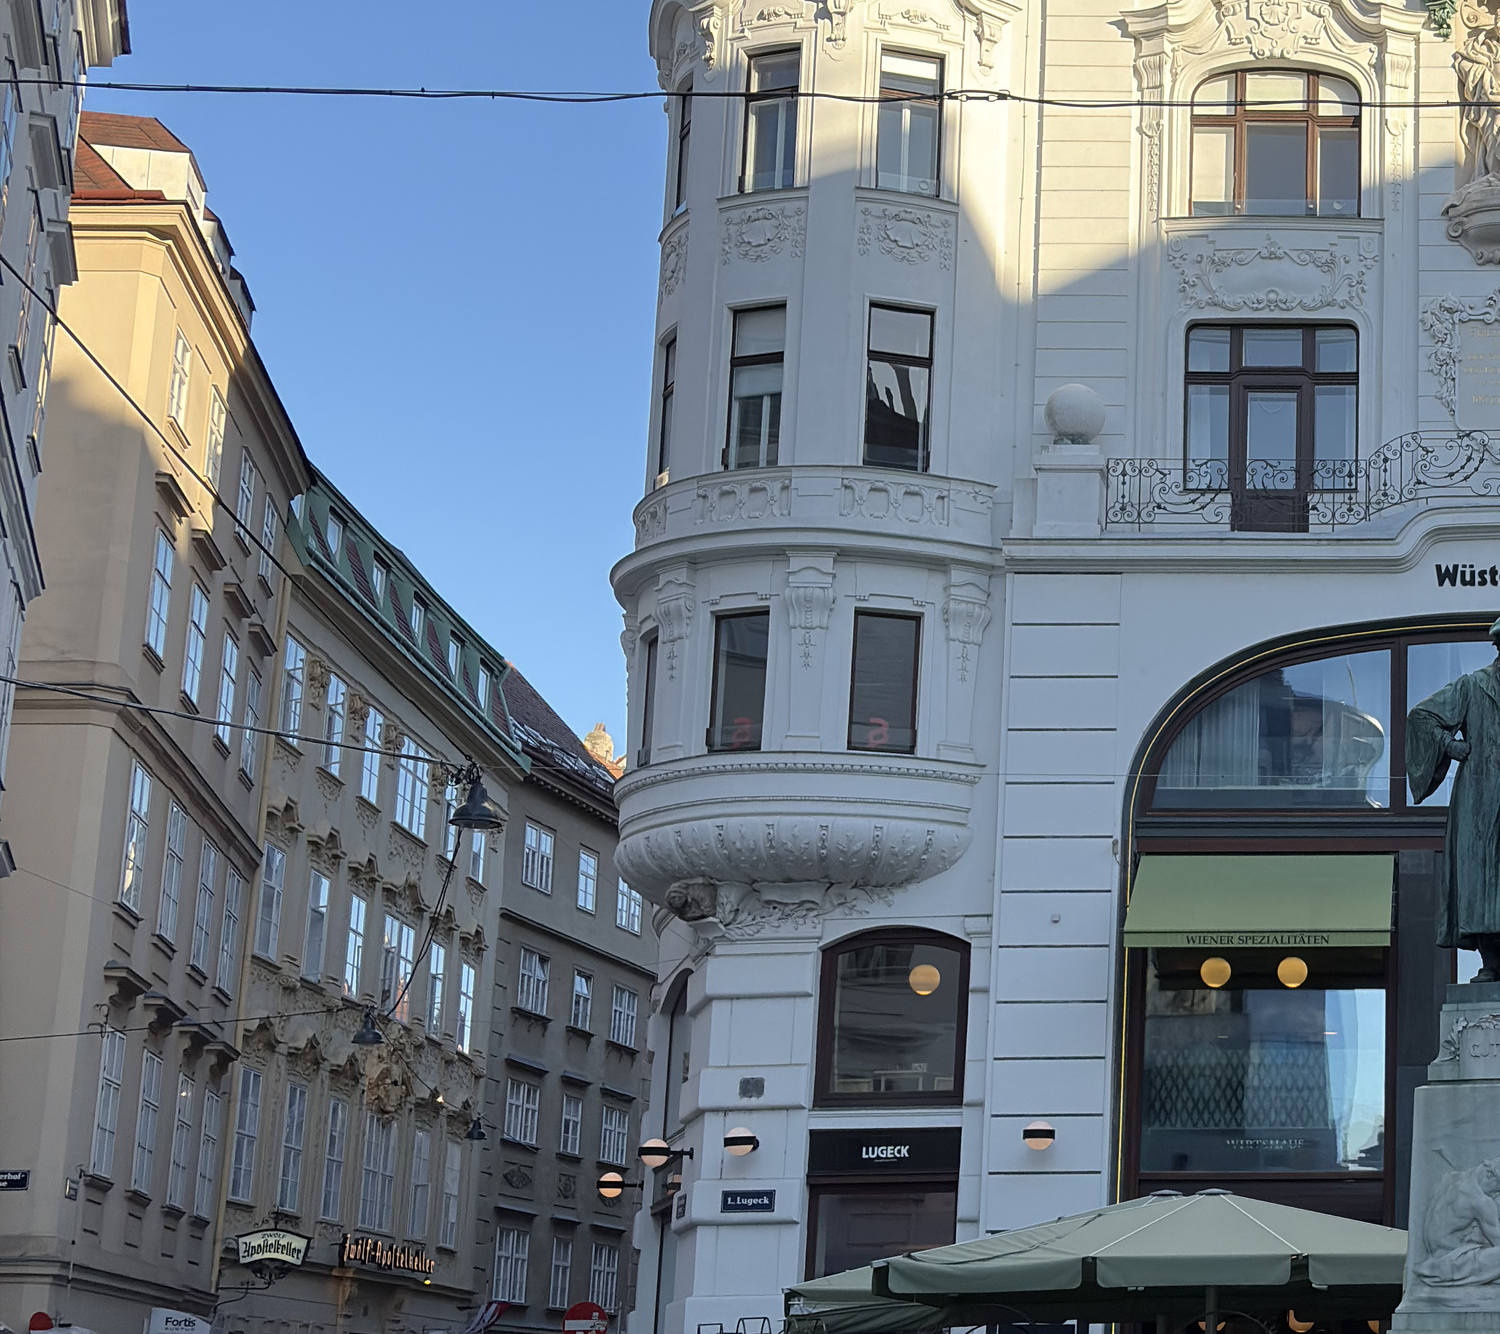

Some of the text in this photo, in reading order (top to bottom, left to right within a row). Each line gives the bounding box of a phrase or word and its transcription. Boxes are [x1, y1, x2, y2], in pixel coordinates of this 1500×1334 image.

[1186, 933, 1330, 945] WIENER SPEZIALITÄTEN
[862, 1145, 910, 1158] LUGECK
[736, 1196, 770, 1206] Lugeck
[164, 1317, 197, 1327] Fortis
